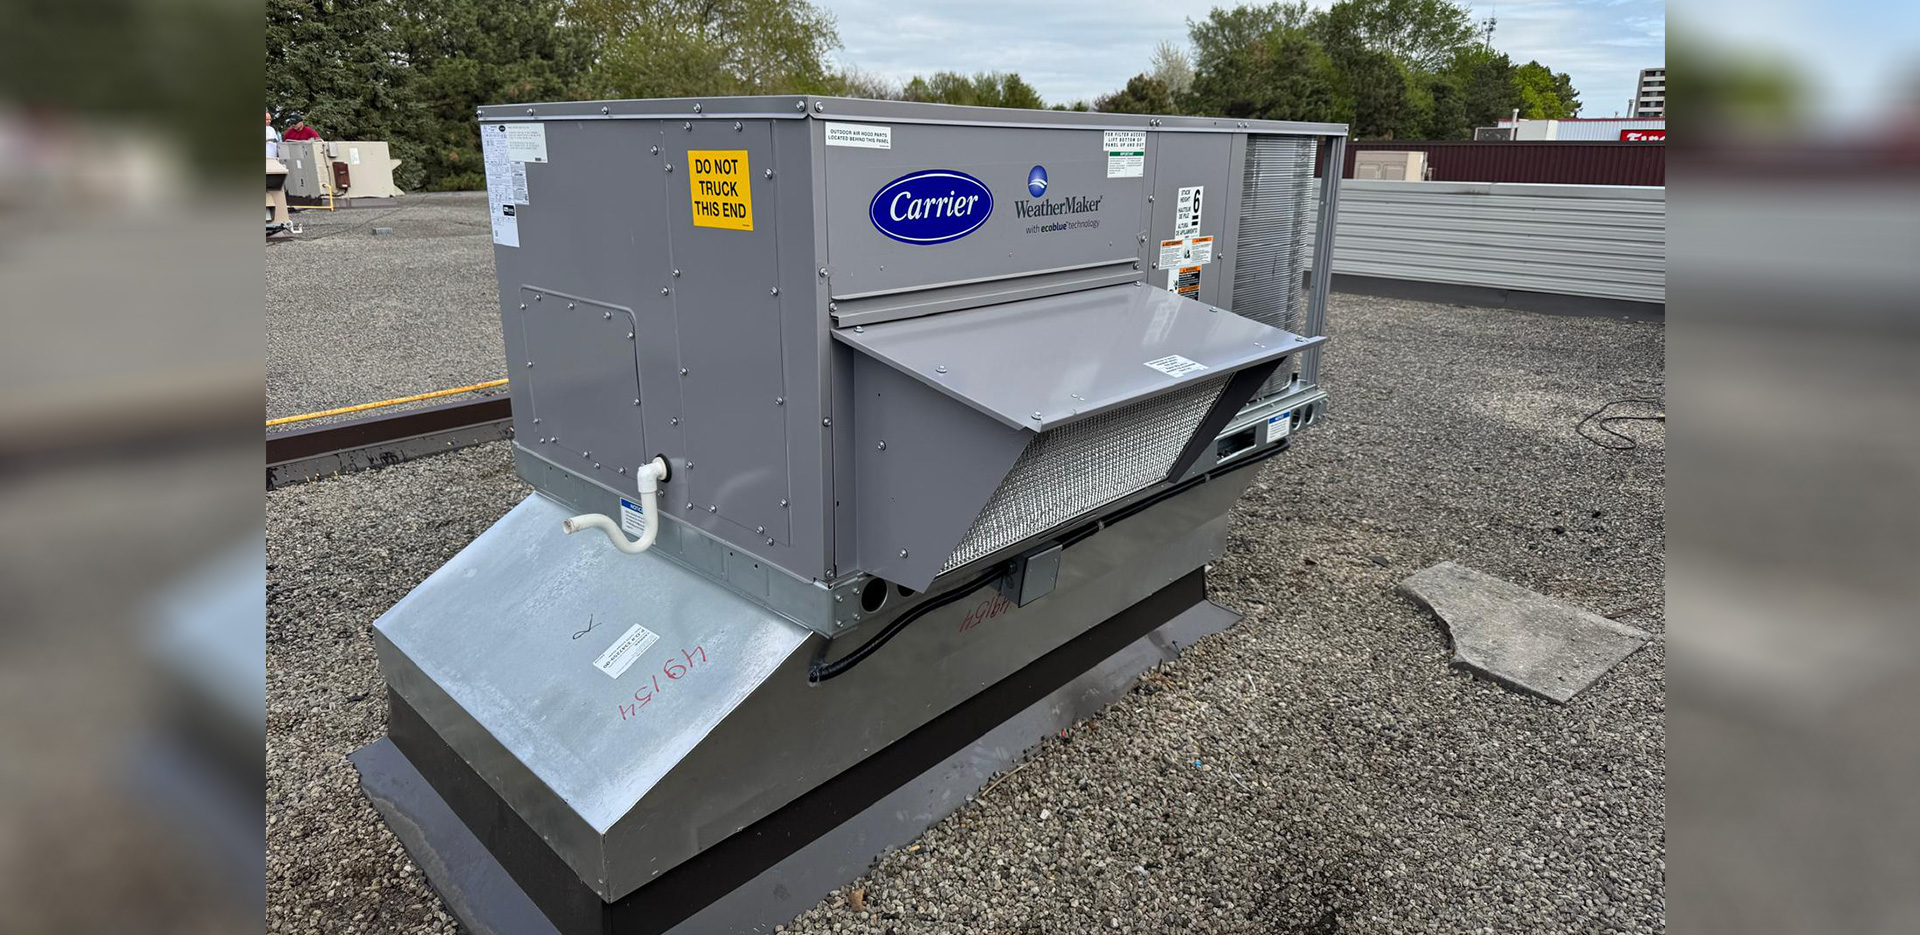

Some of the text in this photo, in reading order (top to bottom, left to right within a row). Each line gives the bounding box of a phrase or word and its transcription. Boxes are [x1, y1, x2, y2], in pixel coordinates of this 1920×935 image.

[695, 159, 738, 174] DO NOT
[699, 181, 738, 197] TRUCK
[694, 201, 746, 218] THIS END
[890, 190, 979, 222] Carrier
[1015, 196, 1102, 218] WeatherMaker
[1193, 189, 1201, 213] 6
[1026, 224, 1040, 234] with
[1068, 220, 1100, 229] technology
[619, 646, 706, 720] 49154
